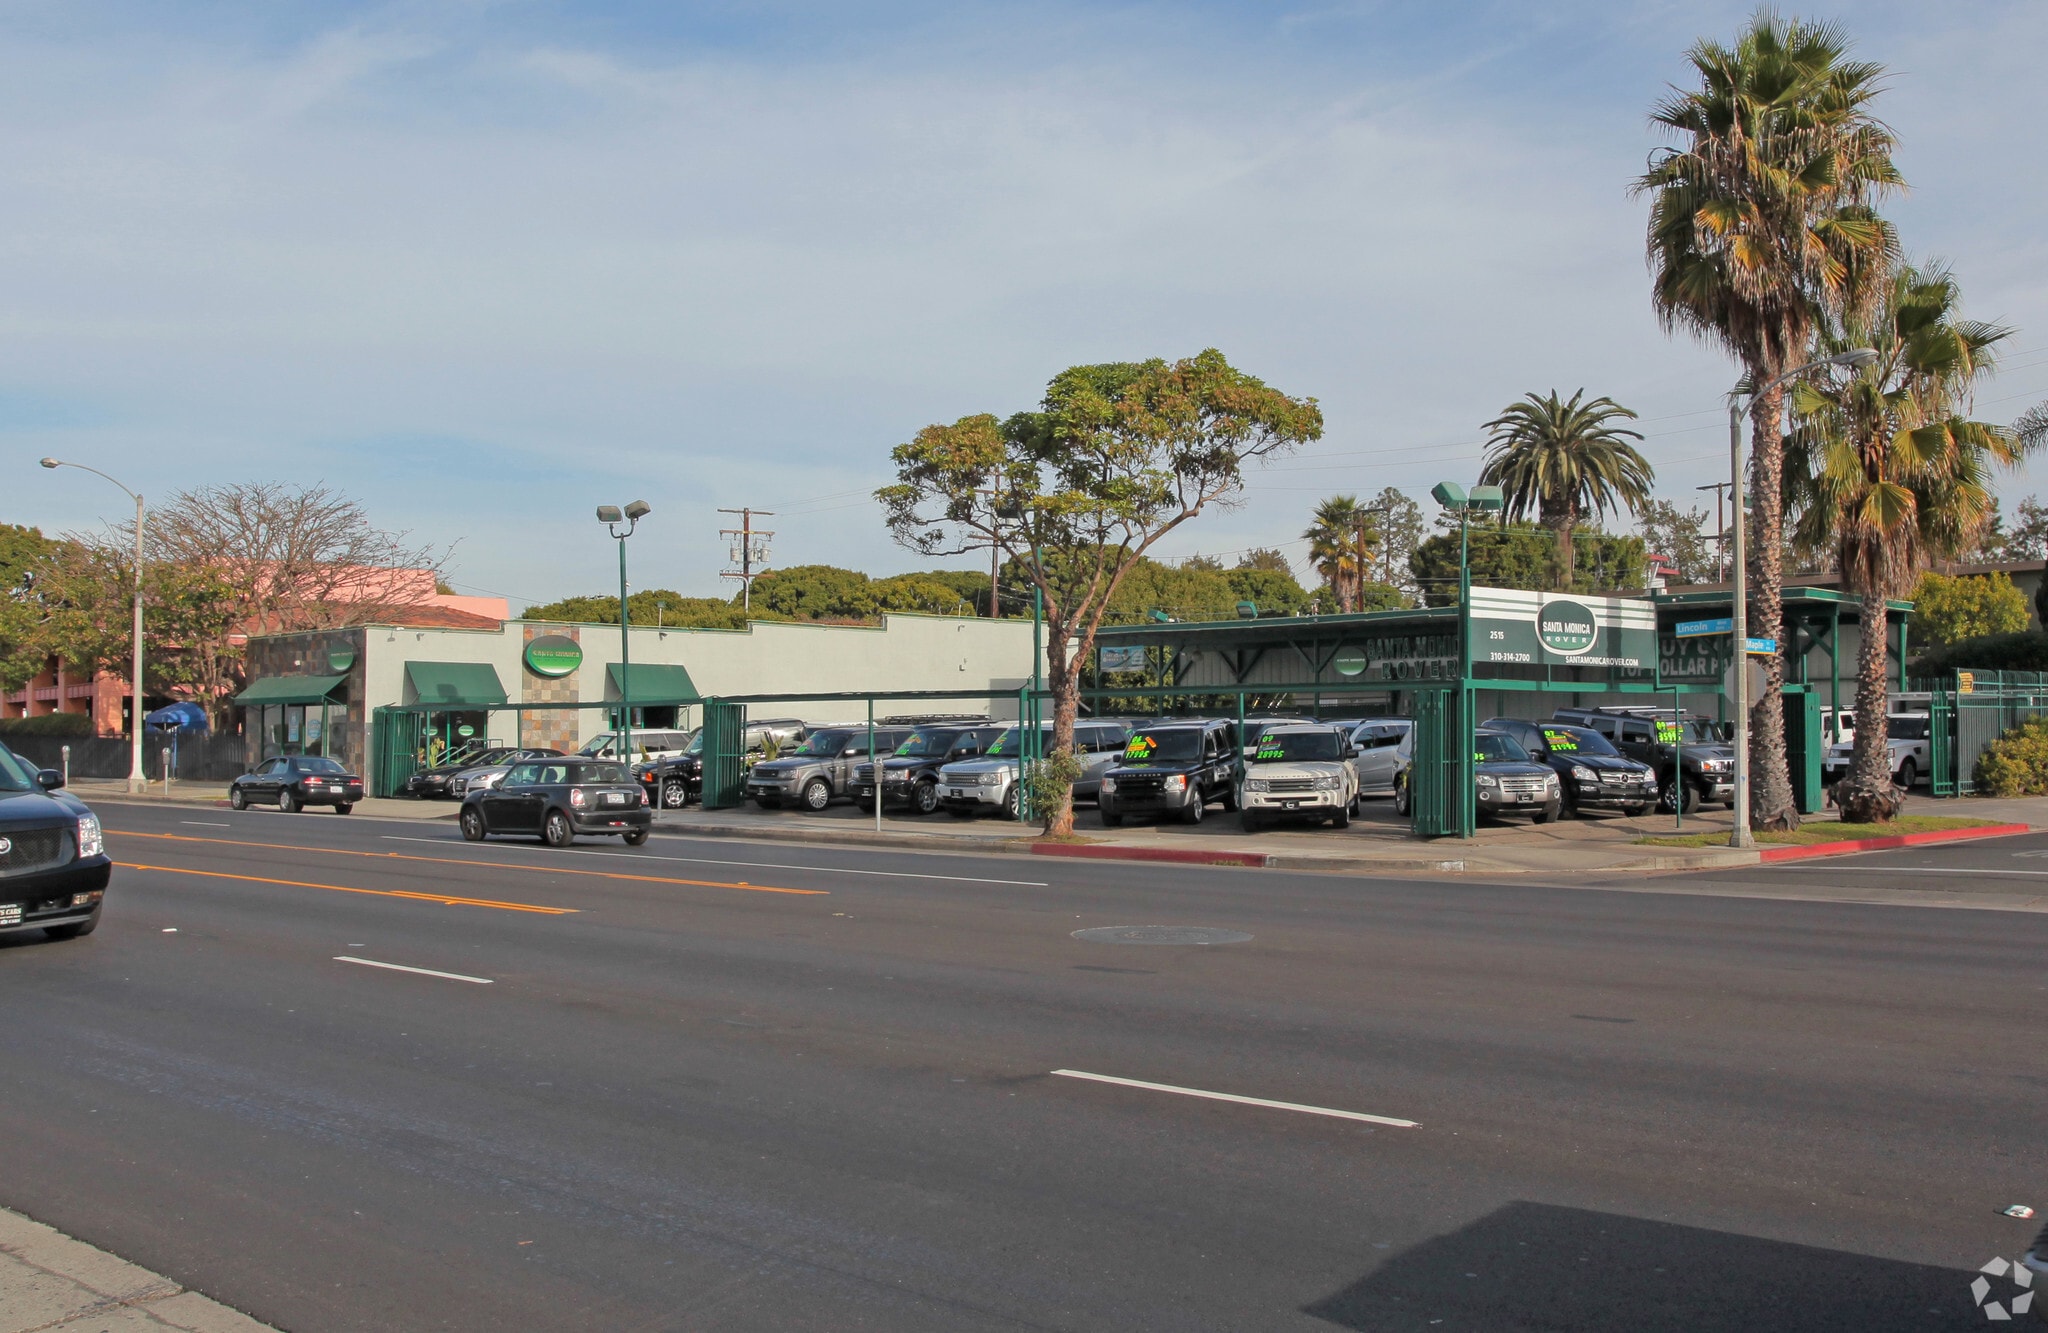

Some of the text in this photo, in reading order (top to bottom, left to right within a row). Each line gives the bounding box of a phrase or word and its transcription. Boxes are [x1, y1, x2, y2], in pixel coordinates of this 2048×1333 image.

[1542, 621, 1591, 635] SANTA MONICA
[1677, 621, 1708, 633] Lincoln
[1489, 631, 1505, 640] 2515
[1367, 638, 1411, 660] SANTA
[1661, 639, 1691, 657] UY
[1746, 639, 1764, 651] Maple
[1490, 652, 1530, 662] 310-314-2700
[1565, 655, 1639, 667] SANTAMONICAROVER.COM
[1381, 660, 1458, 679] ROVER
[1650, 657, 1706, 676] OLLAR
